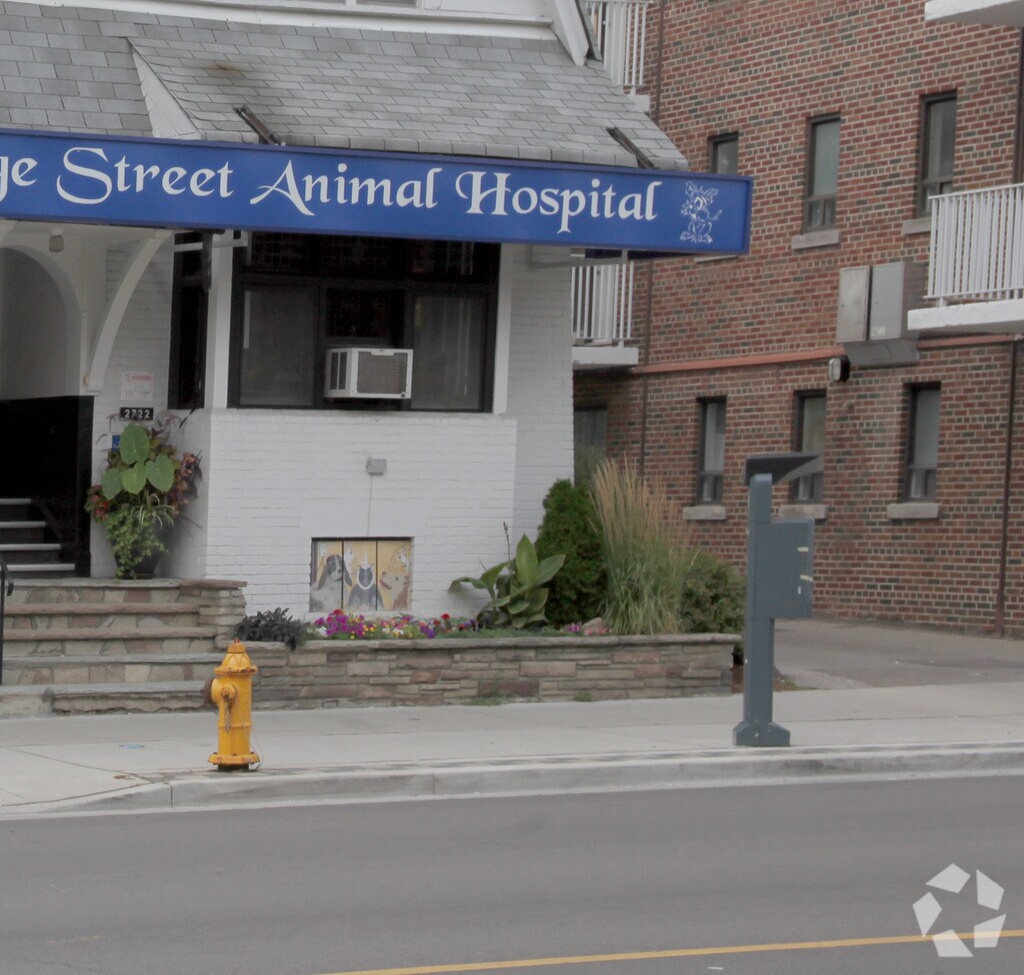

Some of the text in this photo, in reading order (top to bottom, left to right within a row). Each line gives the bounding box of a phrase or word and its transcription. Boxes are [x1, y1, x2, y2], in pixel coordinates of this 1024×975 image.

[56, 146, 234, 205] Street
[249, 159, 443, 216] Animal
[455, 170, 663, 233] Hospital
[124, 409, 150, 418] 2722
